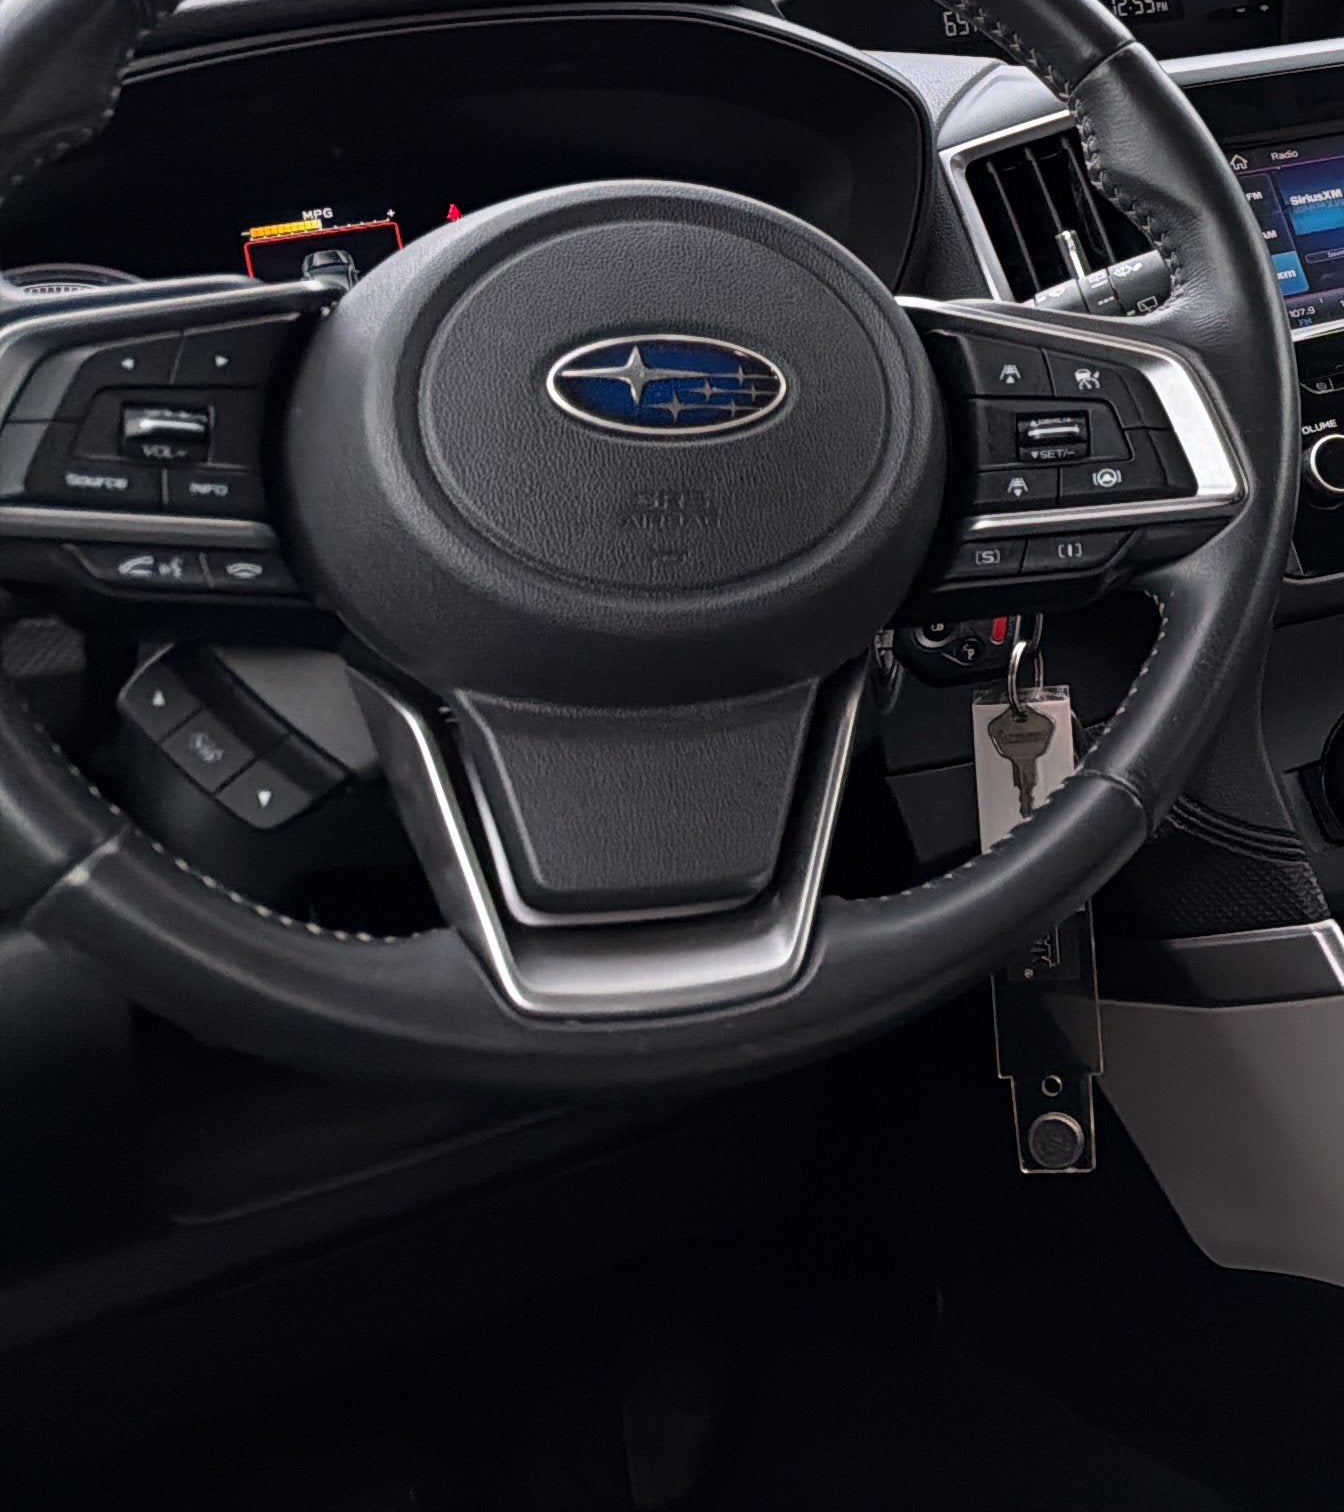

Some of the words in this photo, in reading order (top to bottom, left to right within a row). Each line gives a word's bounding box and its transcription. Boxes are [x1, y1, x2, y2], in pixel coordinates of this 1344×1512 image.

[1156, 1, 1169, 12] PM
[1270, 149, 1299, 162] Radio
[1289, 188, 1344, 207] SiriusXM
[302, 207, 334, 220] MPG
[1288, 306, 1316, 319] 107.9
[1301, 418, 1338, 435] OLUME
